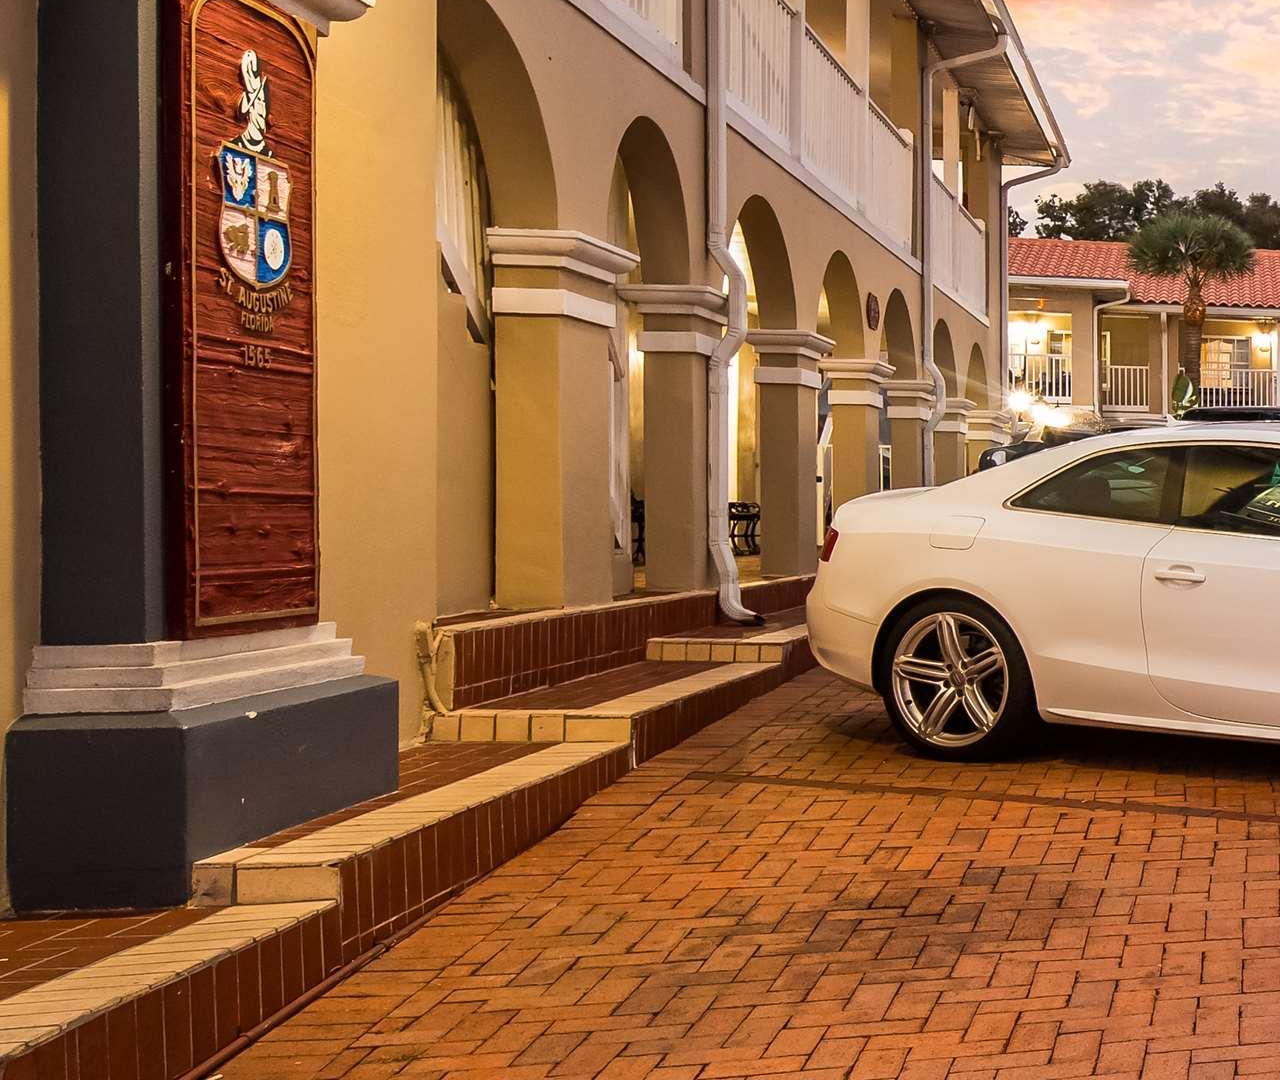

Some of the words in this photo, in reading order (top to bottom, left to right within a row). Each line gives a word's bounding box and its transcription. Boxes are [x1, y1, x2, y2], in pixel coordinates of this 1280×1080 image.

[239, 282, 293, 313] AUGUSTINE
[241, 311, 273, 333] FLORIDA
[241, 344, 272, 369] 1565
